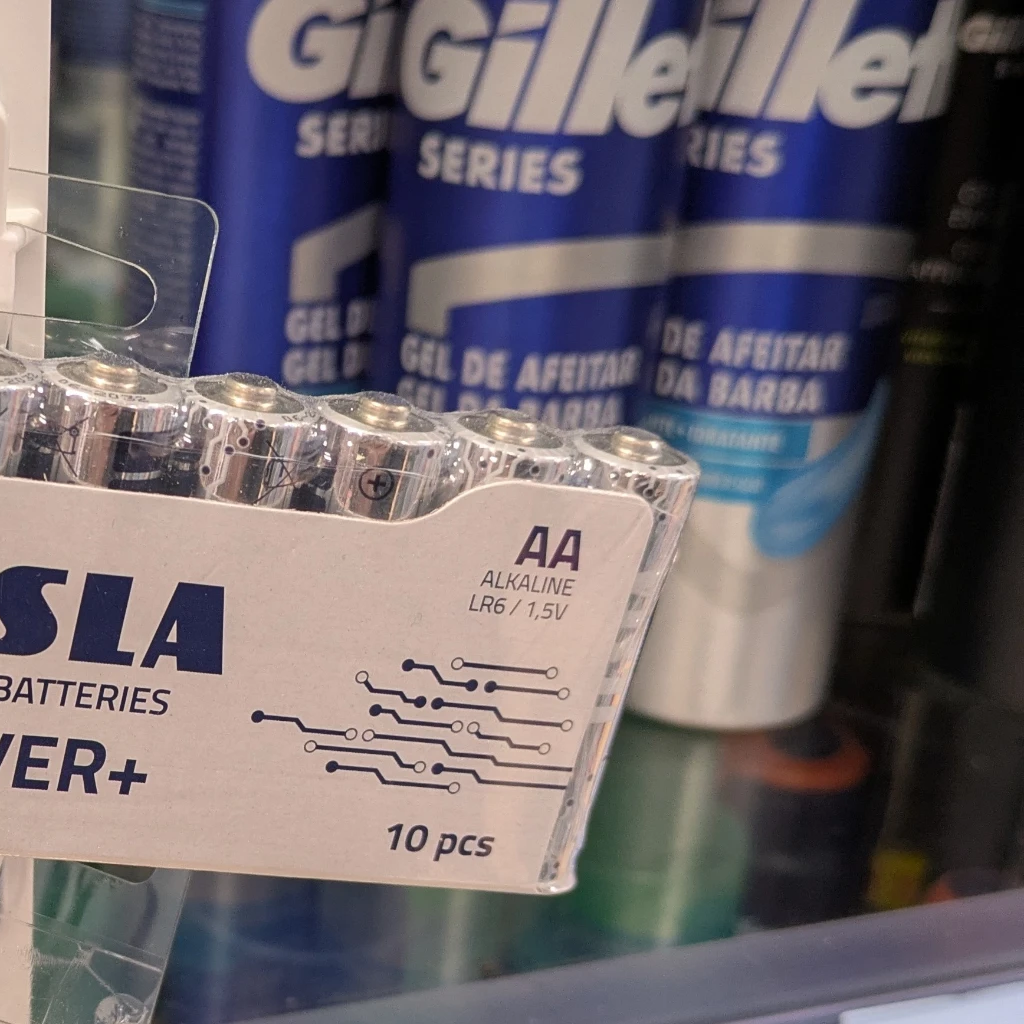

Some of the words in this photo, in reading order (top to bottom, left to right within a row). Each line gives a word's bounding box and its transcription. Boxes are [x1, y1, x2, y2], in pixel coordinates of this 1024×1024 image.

[417, 132, 584, 197] SERIES
[684, 128, 784, 178] RIES
[286, 306, 341, 345] GEL
[661, 316, 704, 361] DE
[708, 327, 845, 373] AFEITAR
[282, 346, 337, 386] GEL
[400, 334, 452, 383] GEL
[462, 347, 509, 391] DE
[515, 347, 641, 395] AFEITAR
[656, 358, 699, 401] DA
[707, 370, 824, 415] BARBA
[514, 525, 583, 572] AA
[468, 593, 506, 615] LR6
[526, 601, 569, 621] 1,5V
[480, 570, 575, 598] ALKALINE
[387, 823, 429, 853] 10
[433, 834, 495, 862] pcs
